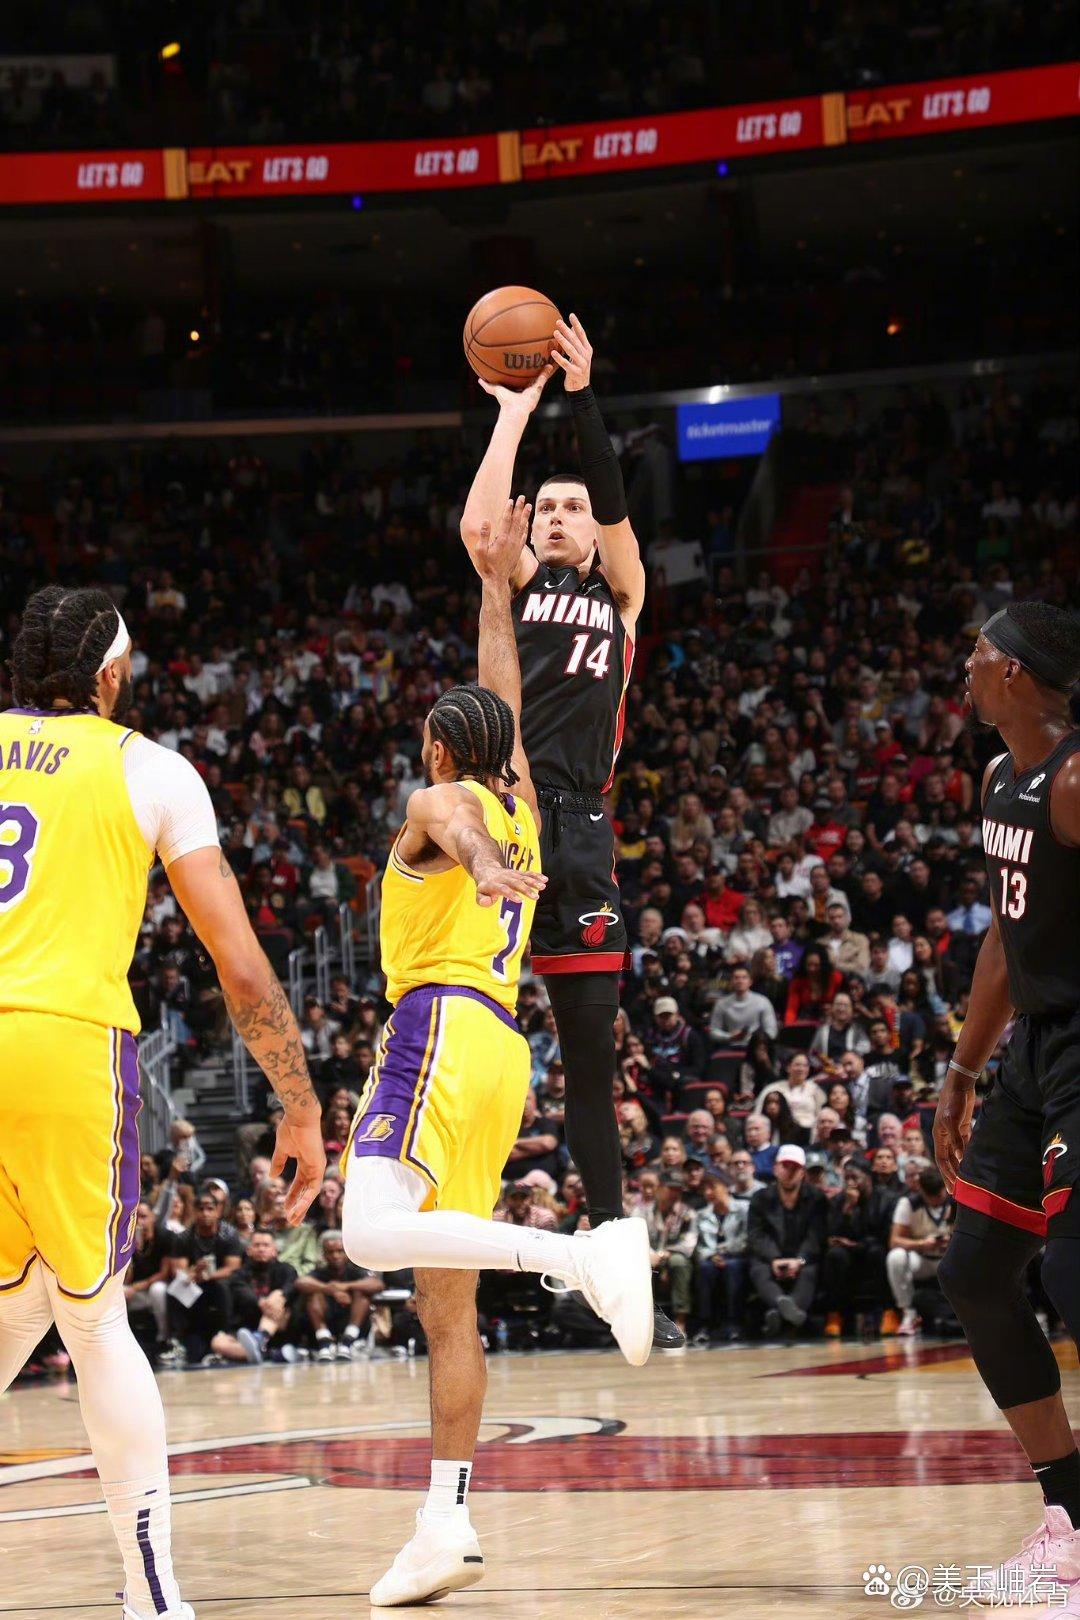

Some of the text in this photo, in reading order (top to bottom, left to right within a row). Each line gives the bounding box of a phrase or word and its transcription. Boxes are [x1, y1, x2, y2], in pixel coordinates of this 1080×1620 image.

[922, 87, 991, 119] LET'S GO
[736, 111, 802, 143] LET'S GO
[594, 129, 658, 159] LET'S GO
[77, 162, 144, 188] LET'S GO
[263, 156, 329, 182] LET'S GO
[414, 148, 479, 176] LET'S GO
[686, 420, 771, 440] ticketmaster
[522, 593, 614, 634] MIAMI
[564, 633, 612, 679] 14
[1000, 867, 1028, 919] 13
[493, 896, 523, 977] 7
